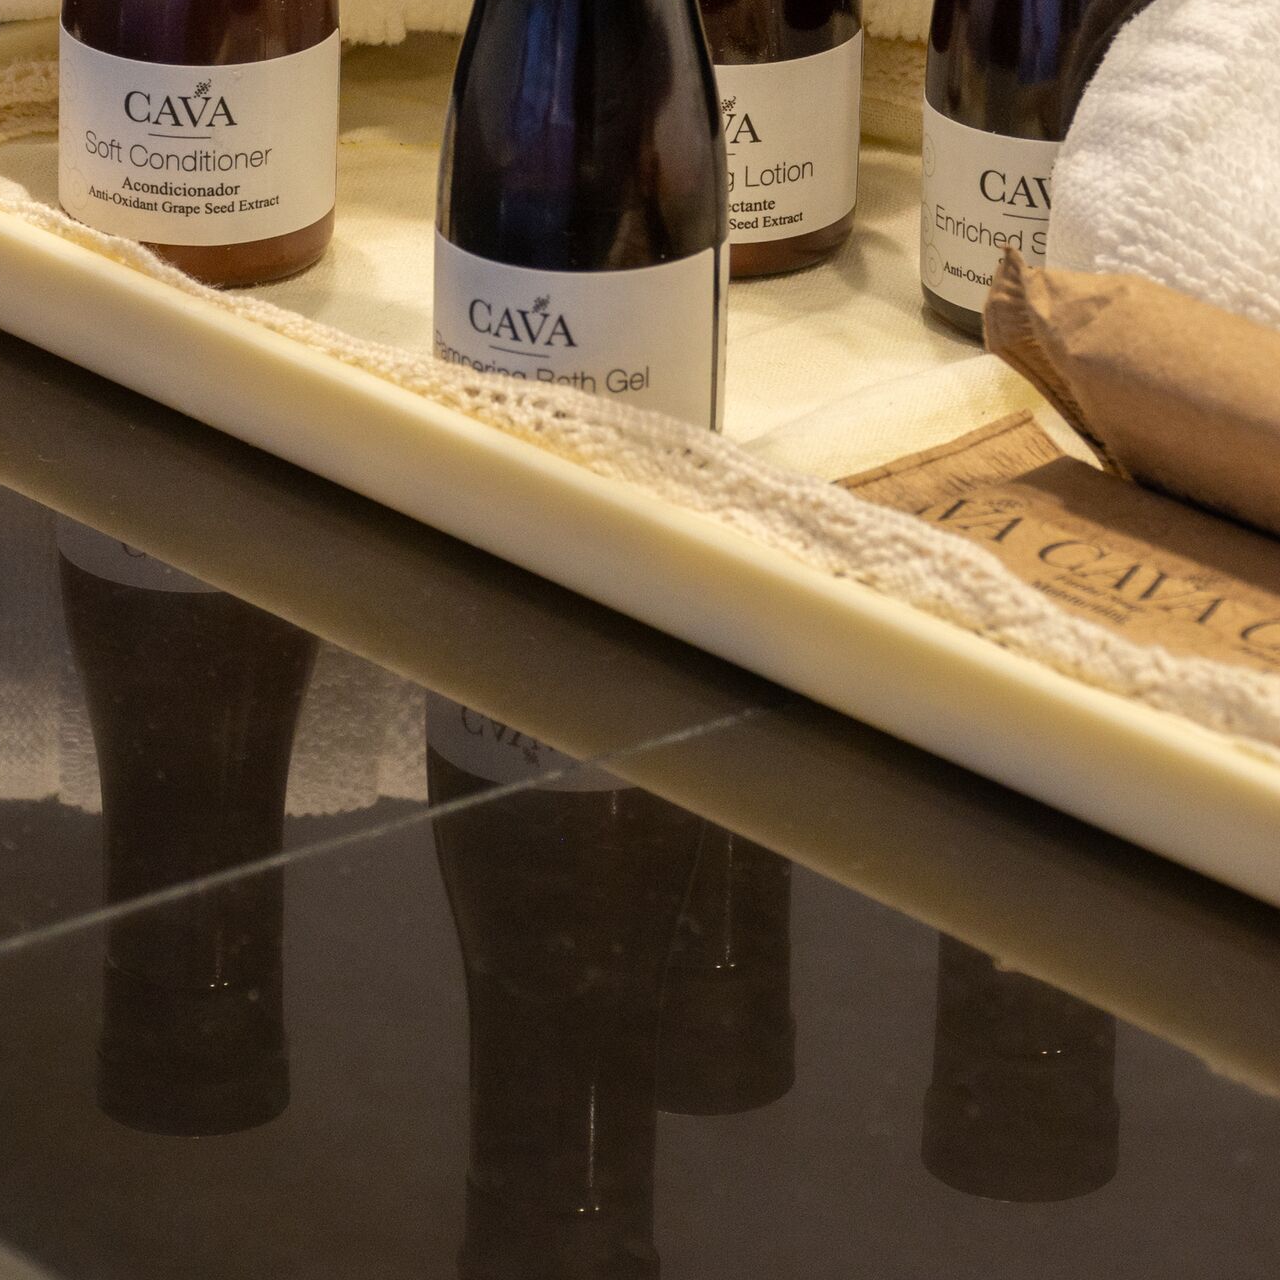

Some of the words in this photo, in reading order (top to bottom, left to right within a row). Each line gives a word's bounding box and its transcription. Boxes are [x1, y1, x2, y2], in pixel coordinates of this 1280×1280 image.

[123, 91, 238, 128] CAVA
[85, 130, 123, 164] Soft
[129, 144, 273, 172] Conditioner
[121, 176, 241, 198] Acondicionador
[744, 160, 814, 188] Lotion
[87, 185, 159, 212] Anti-Oxidant
[161, 200, 201, 217] Grape
[204, 201, 235, 215] Seed
[238, 194, 280, 213] Extract
[729, 217, 759, 231] Seed
[762, 211, 803, 228] Extract
[934, 204, 1024, 252] Enriched
[468, 298, 579, 348] CAVA
[606, 365, 650, 394] Gel
